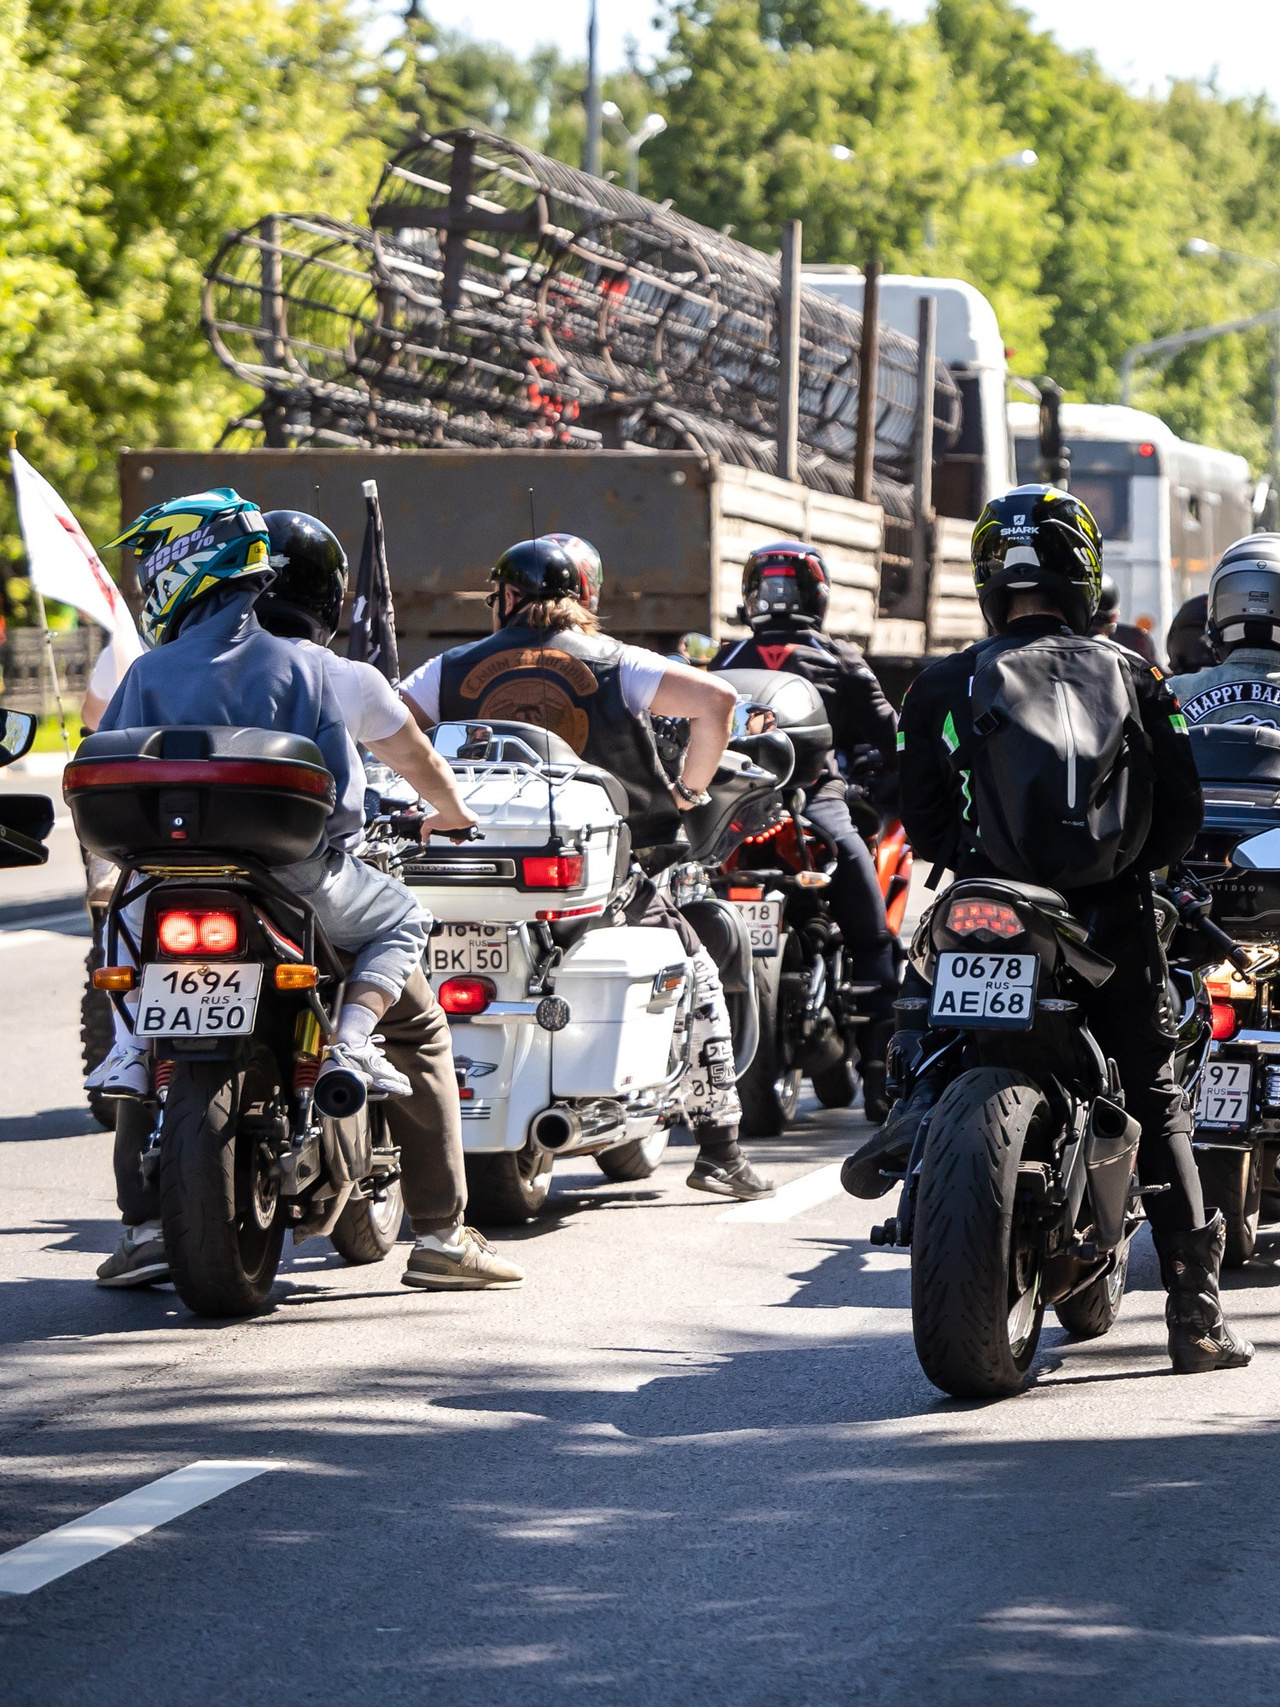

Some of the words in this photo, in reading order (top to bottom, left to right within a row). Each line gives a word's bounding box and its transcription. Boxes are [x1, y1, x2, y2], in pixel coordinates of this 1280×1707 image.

[1000, 526, 1040, 536] SHARK
[145, 526, 215, 579] 100%
[1186, 684, 1244, 719] HAPPY
[1208, 884, 1265, 893] AVIDSON
[469, 939, 487, 947] RUS
[750, 930, 773, 946] 50
[434, 949, 465, 970] BK
[476, 949, 503, 970] 50
[951, 956, 1022, 980] 0678
[162, 970, 242, 994] 1694
[985, 981, 1010, 990] RUS
[200, 995, 230, 1005] RUS
[938, 990, 980, 1013] AE
[989, 992, 1025, 1014] 68
[143, 1006, 192, 1031] BA
[205, 1005, 246, 1030] 50
[1203, 1065, 1240, 1086] 97
[1206, 1087, 1227, 1096] RUS
[1213, 1098, 1243, 1119] 77
